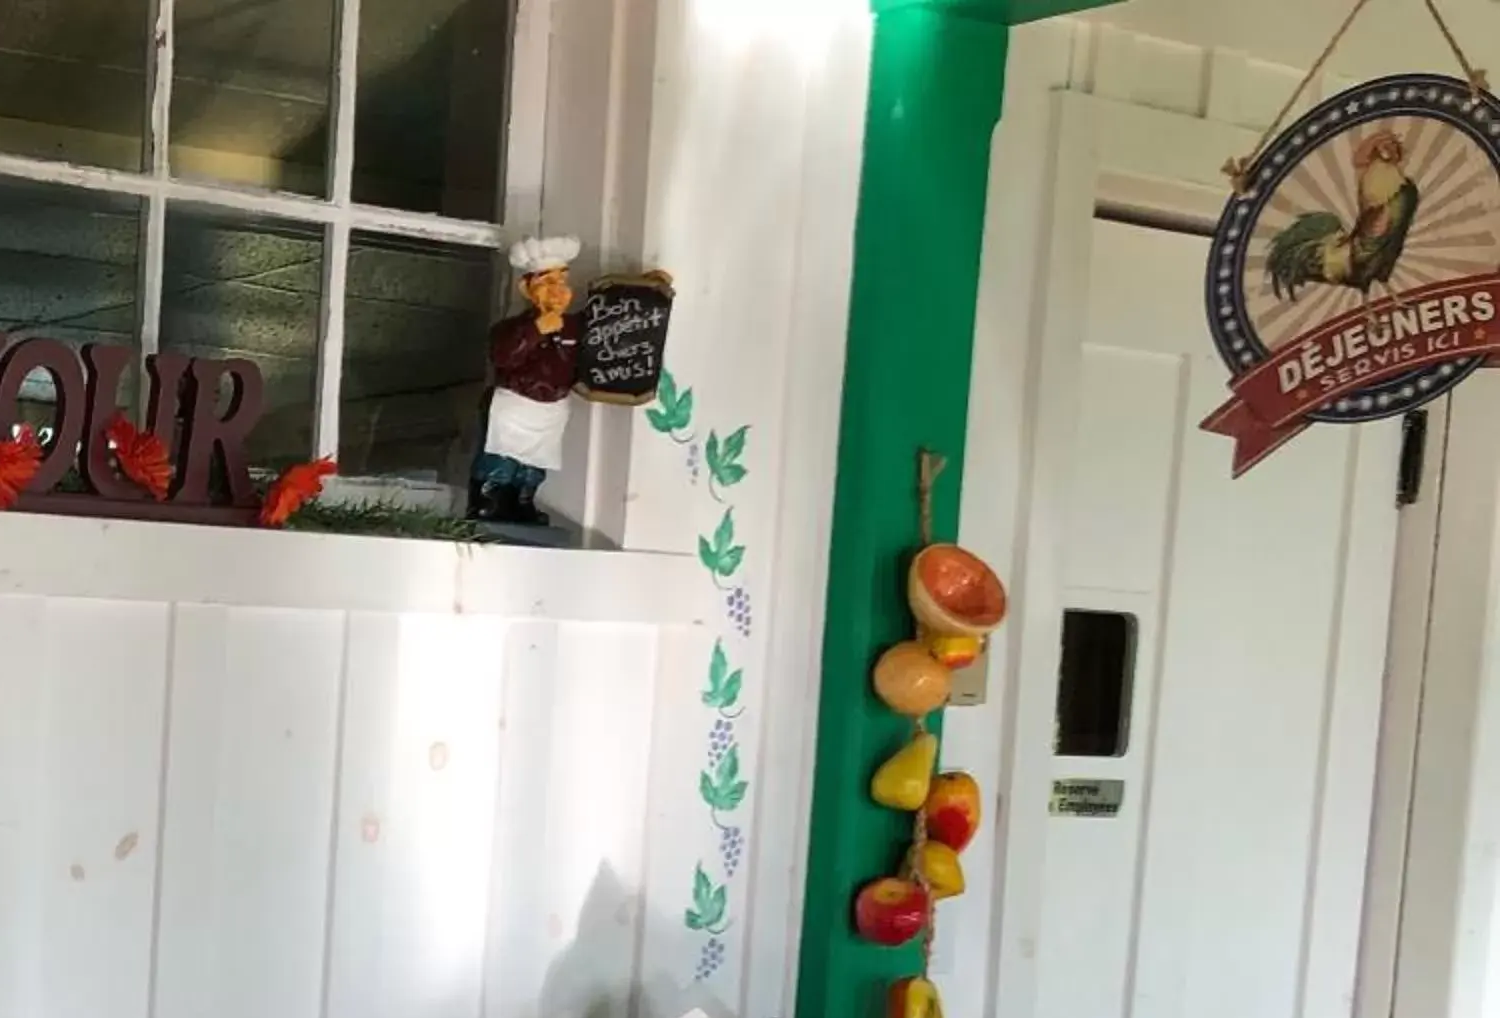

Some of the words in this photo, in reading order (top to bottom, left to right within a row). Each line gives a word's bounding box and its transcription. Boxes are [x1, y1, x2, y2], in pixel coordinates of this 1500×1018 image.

[587, 294, 641, 328] Bon
[1278, 291, 1495, 394] DÉJEUNERS
[1320, 342, 1416, 391] SERVIS
[1427, 331, 1459, 352] ICI
